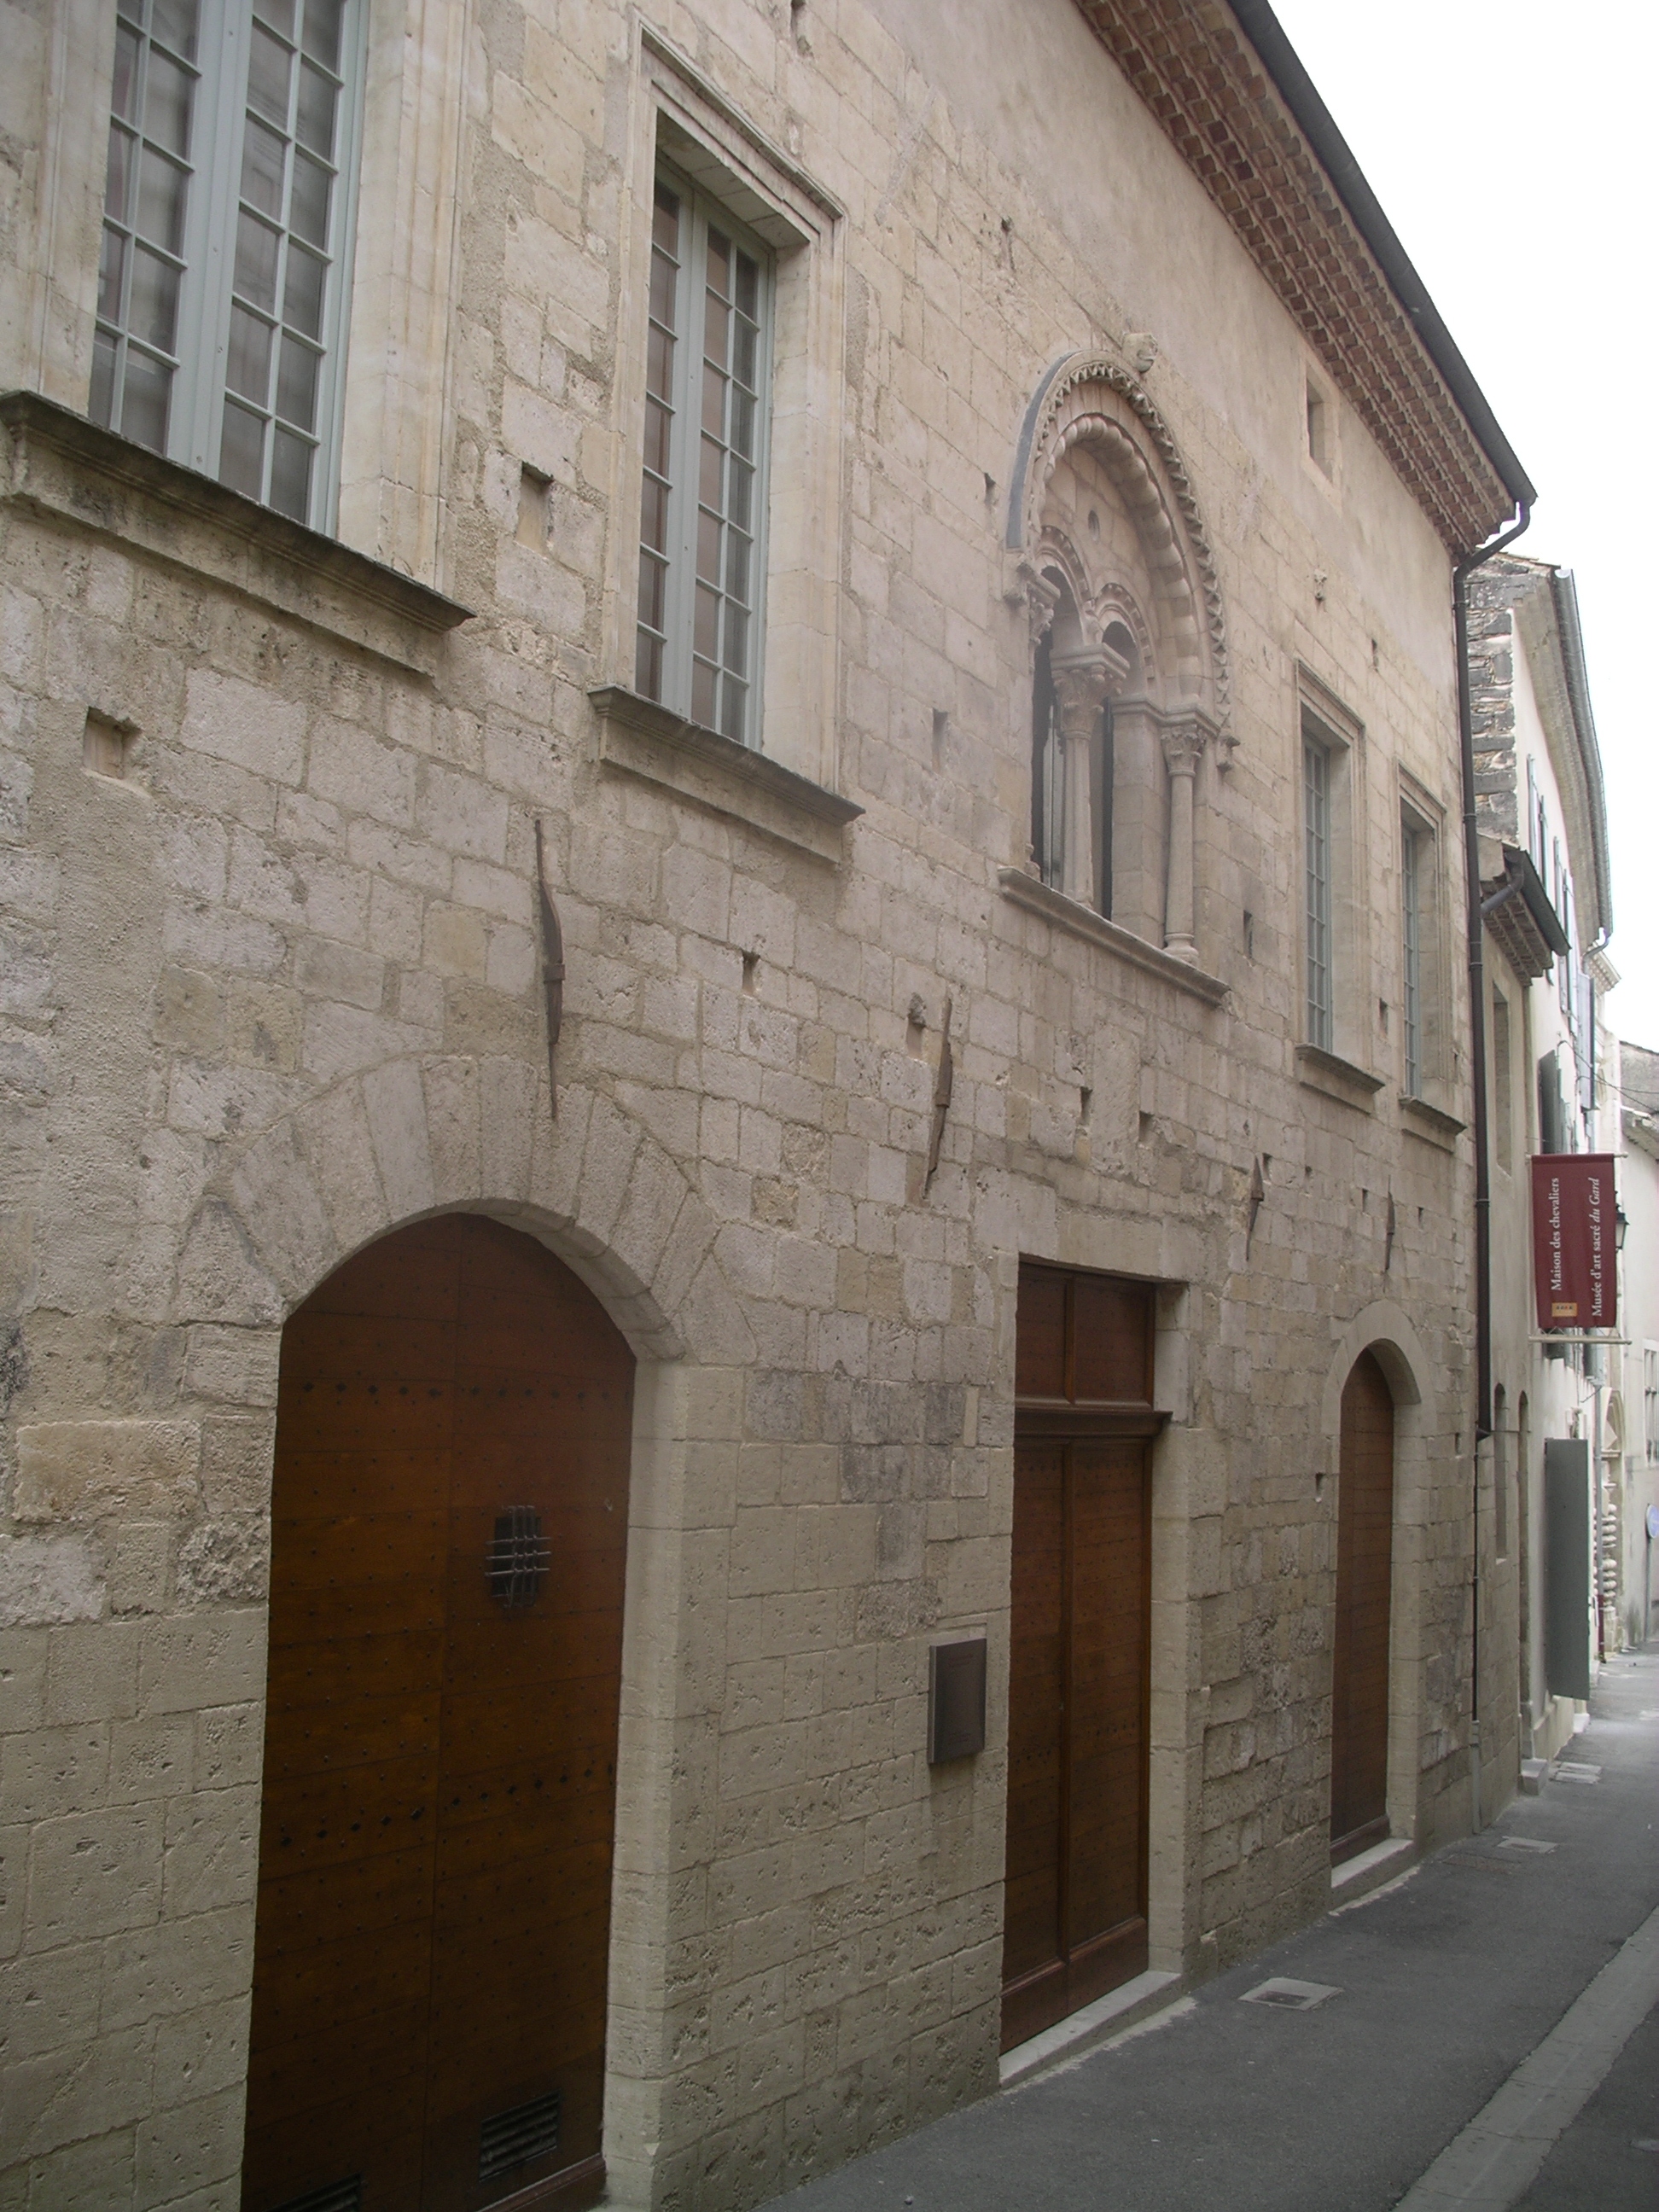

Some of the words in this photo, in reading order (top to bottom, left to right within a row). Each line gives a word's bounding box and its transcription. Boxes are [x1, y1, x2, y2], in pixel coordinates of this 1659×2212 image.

[1548, 1178, 1559, 1228] chevaliers
[1588, 1178, 1600, 1205] Gard
[1589, 1208, 1600, 1223] du
[1550, 1231, 1560, 1249] des
[1590, 1225, 1601, 1252] sacré
[1551, 1251, 1562, 1290] Maison
[1590, 1254, 1601, 1278] d'art
[1592, 1283, 1602, 1316] Musée
